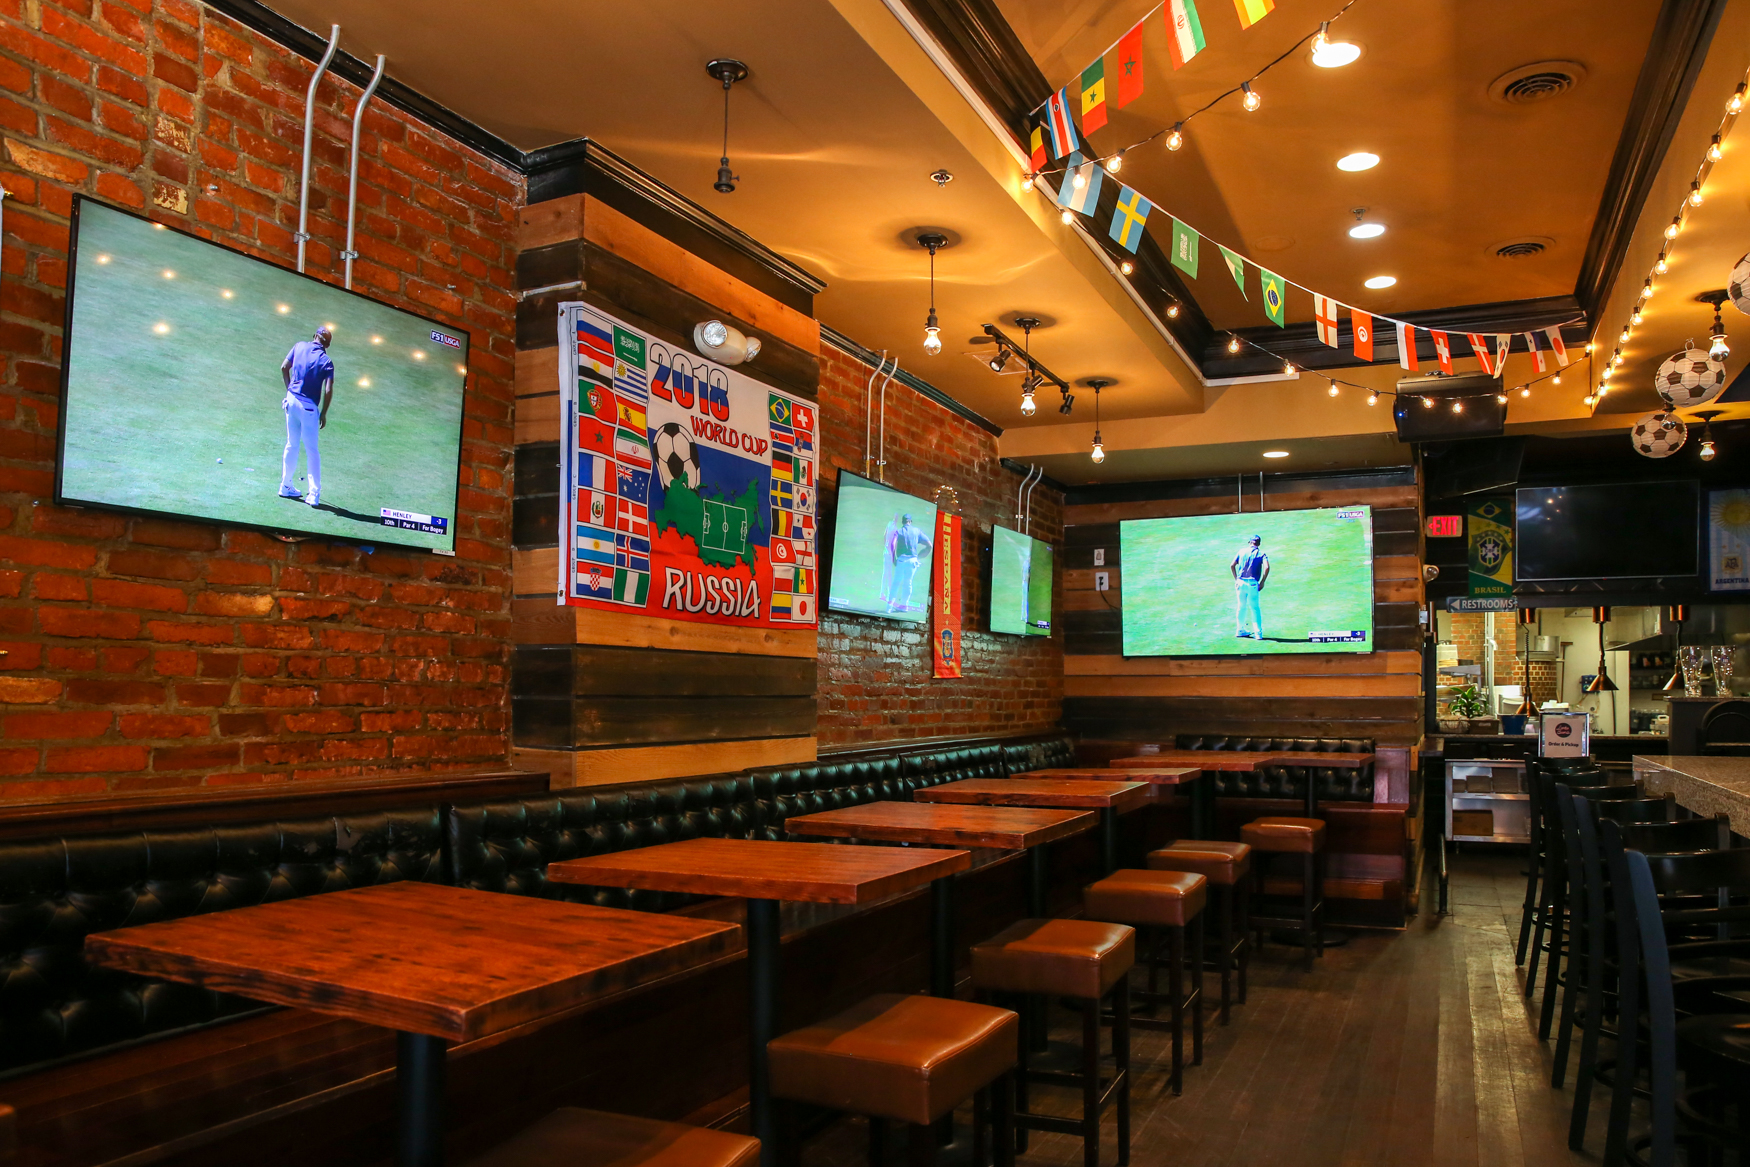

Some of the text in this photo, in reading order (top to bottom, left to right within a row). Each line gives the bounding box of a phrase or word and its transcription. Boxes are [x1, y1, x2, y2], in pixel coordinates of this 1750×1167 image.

[431, 331, 460, 347] FS1 USGA
[649, 342, 730, 422] 2018
[690, 415, 768, 457] WORLD CUP
[392, 511, 413, 520] HENLEY
[1432, 516, 1459, 536] EXIT
[662, 566, 761, 619] RUSSIA
[1461, 599, 1513, 609] RESTROOMS
